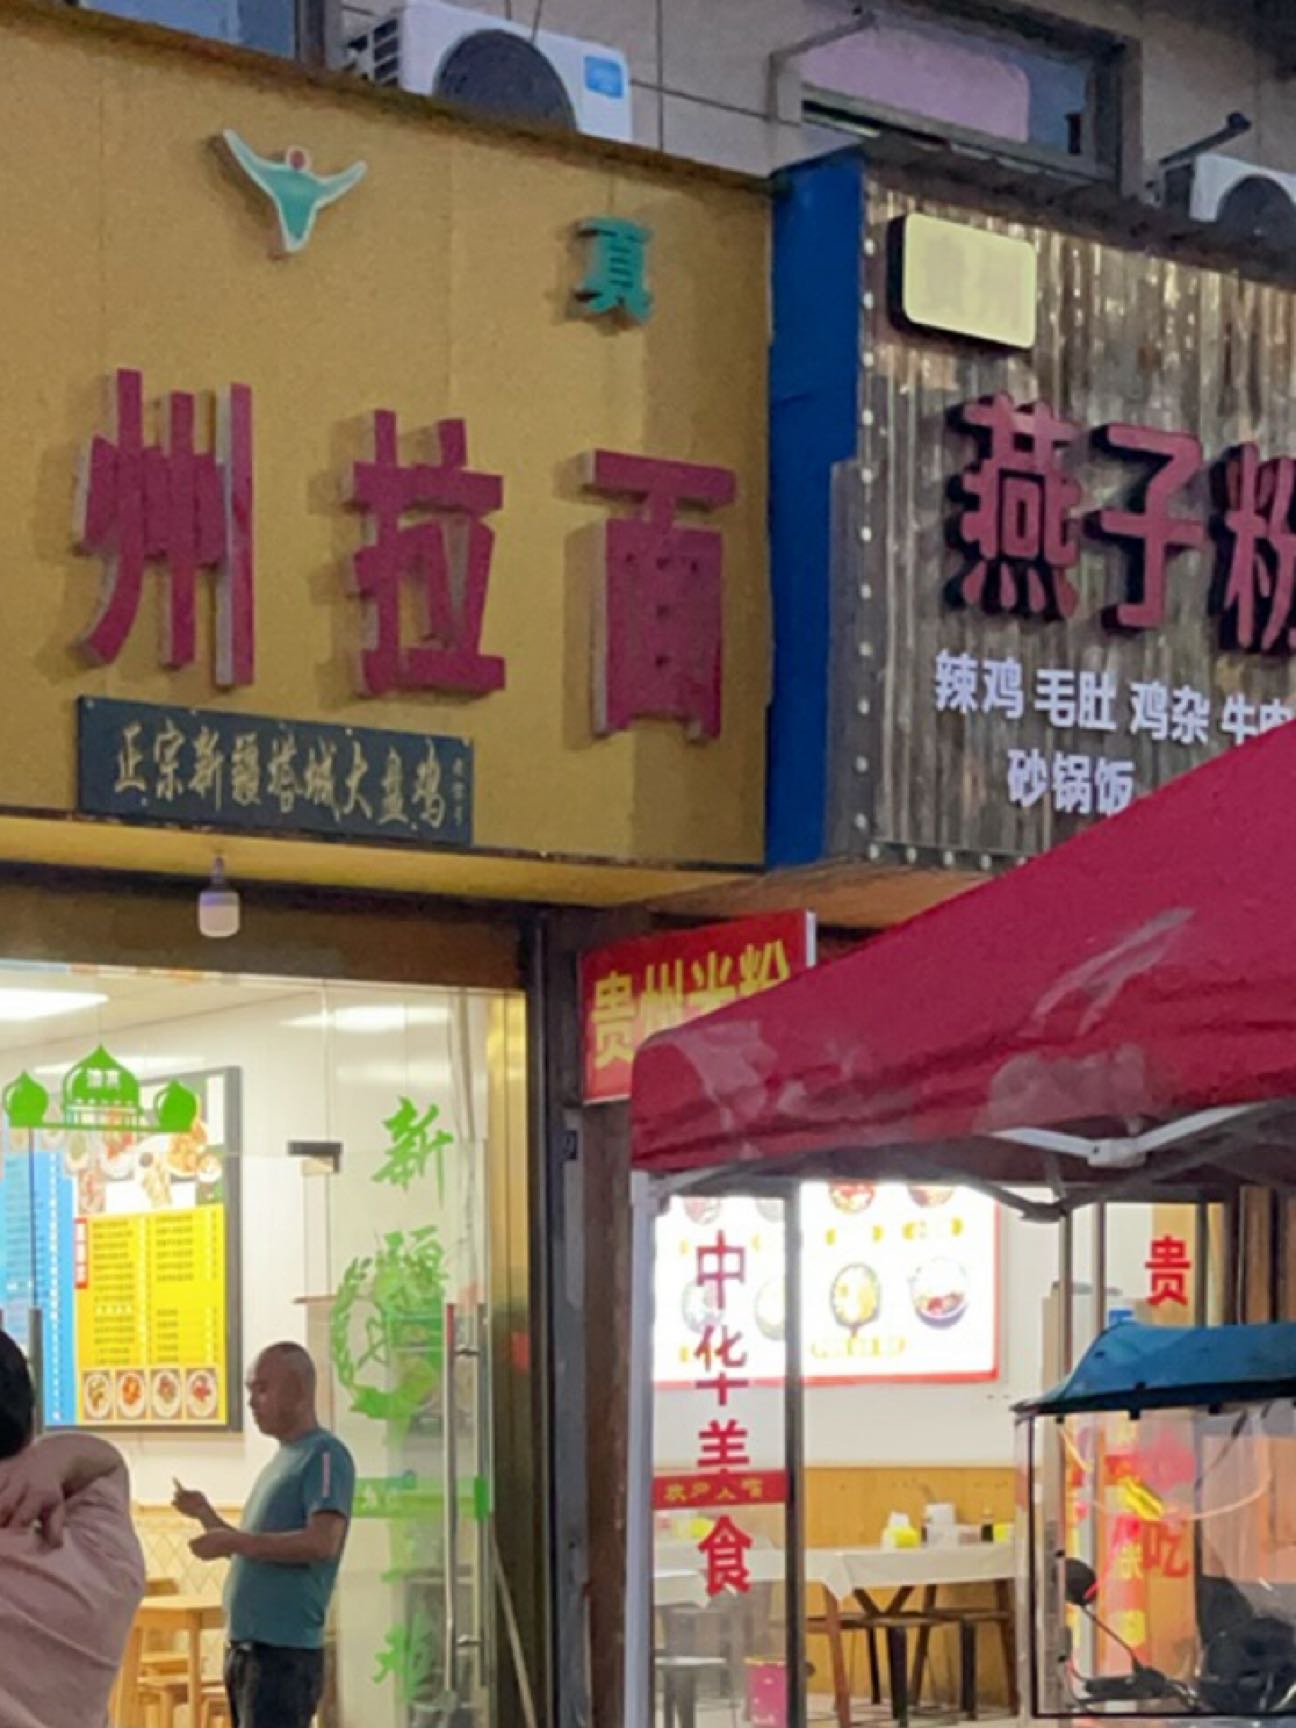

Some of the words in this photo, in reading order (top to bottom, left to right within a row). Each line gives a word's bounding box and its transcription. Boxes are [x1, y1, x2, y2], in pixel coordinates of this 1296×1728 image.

[933, 649, 1024, 722] 辣鸡
[1033, 668, 1116, 732] 毛肚
[1128, 680, 1209, 745] 鸡杂
[1006, 747, 1135, 816] 砂锅饭
[693, 1229, 751, 1597] 中华美食
